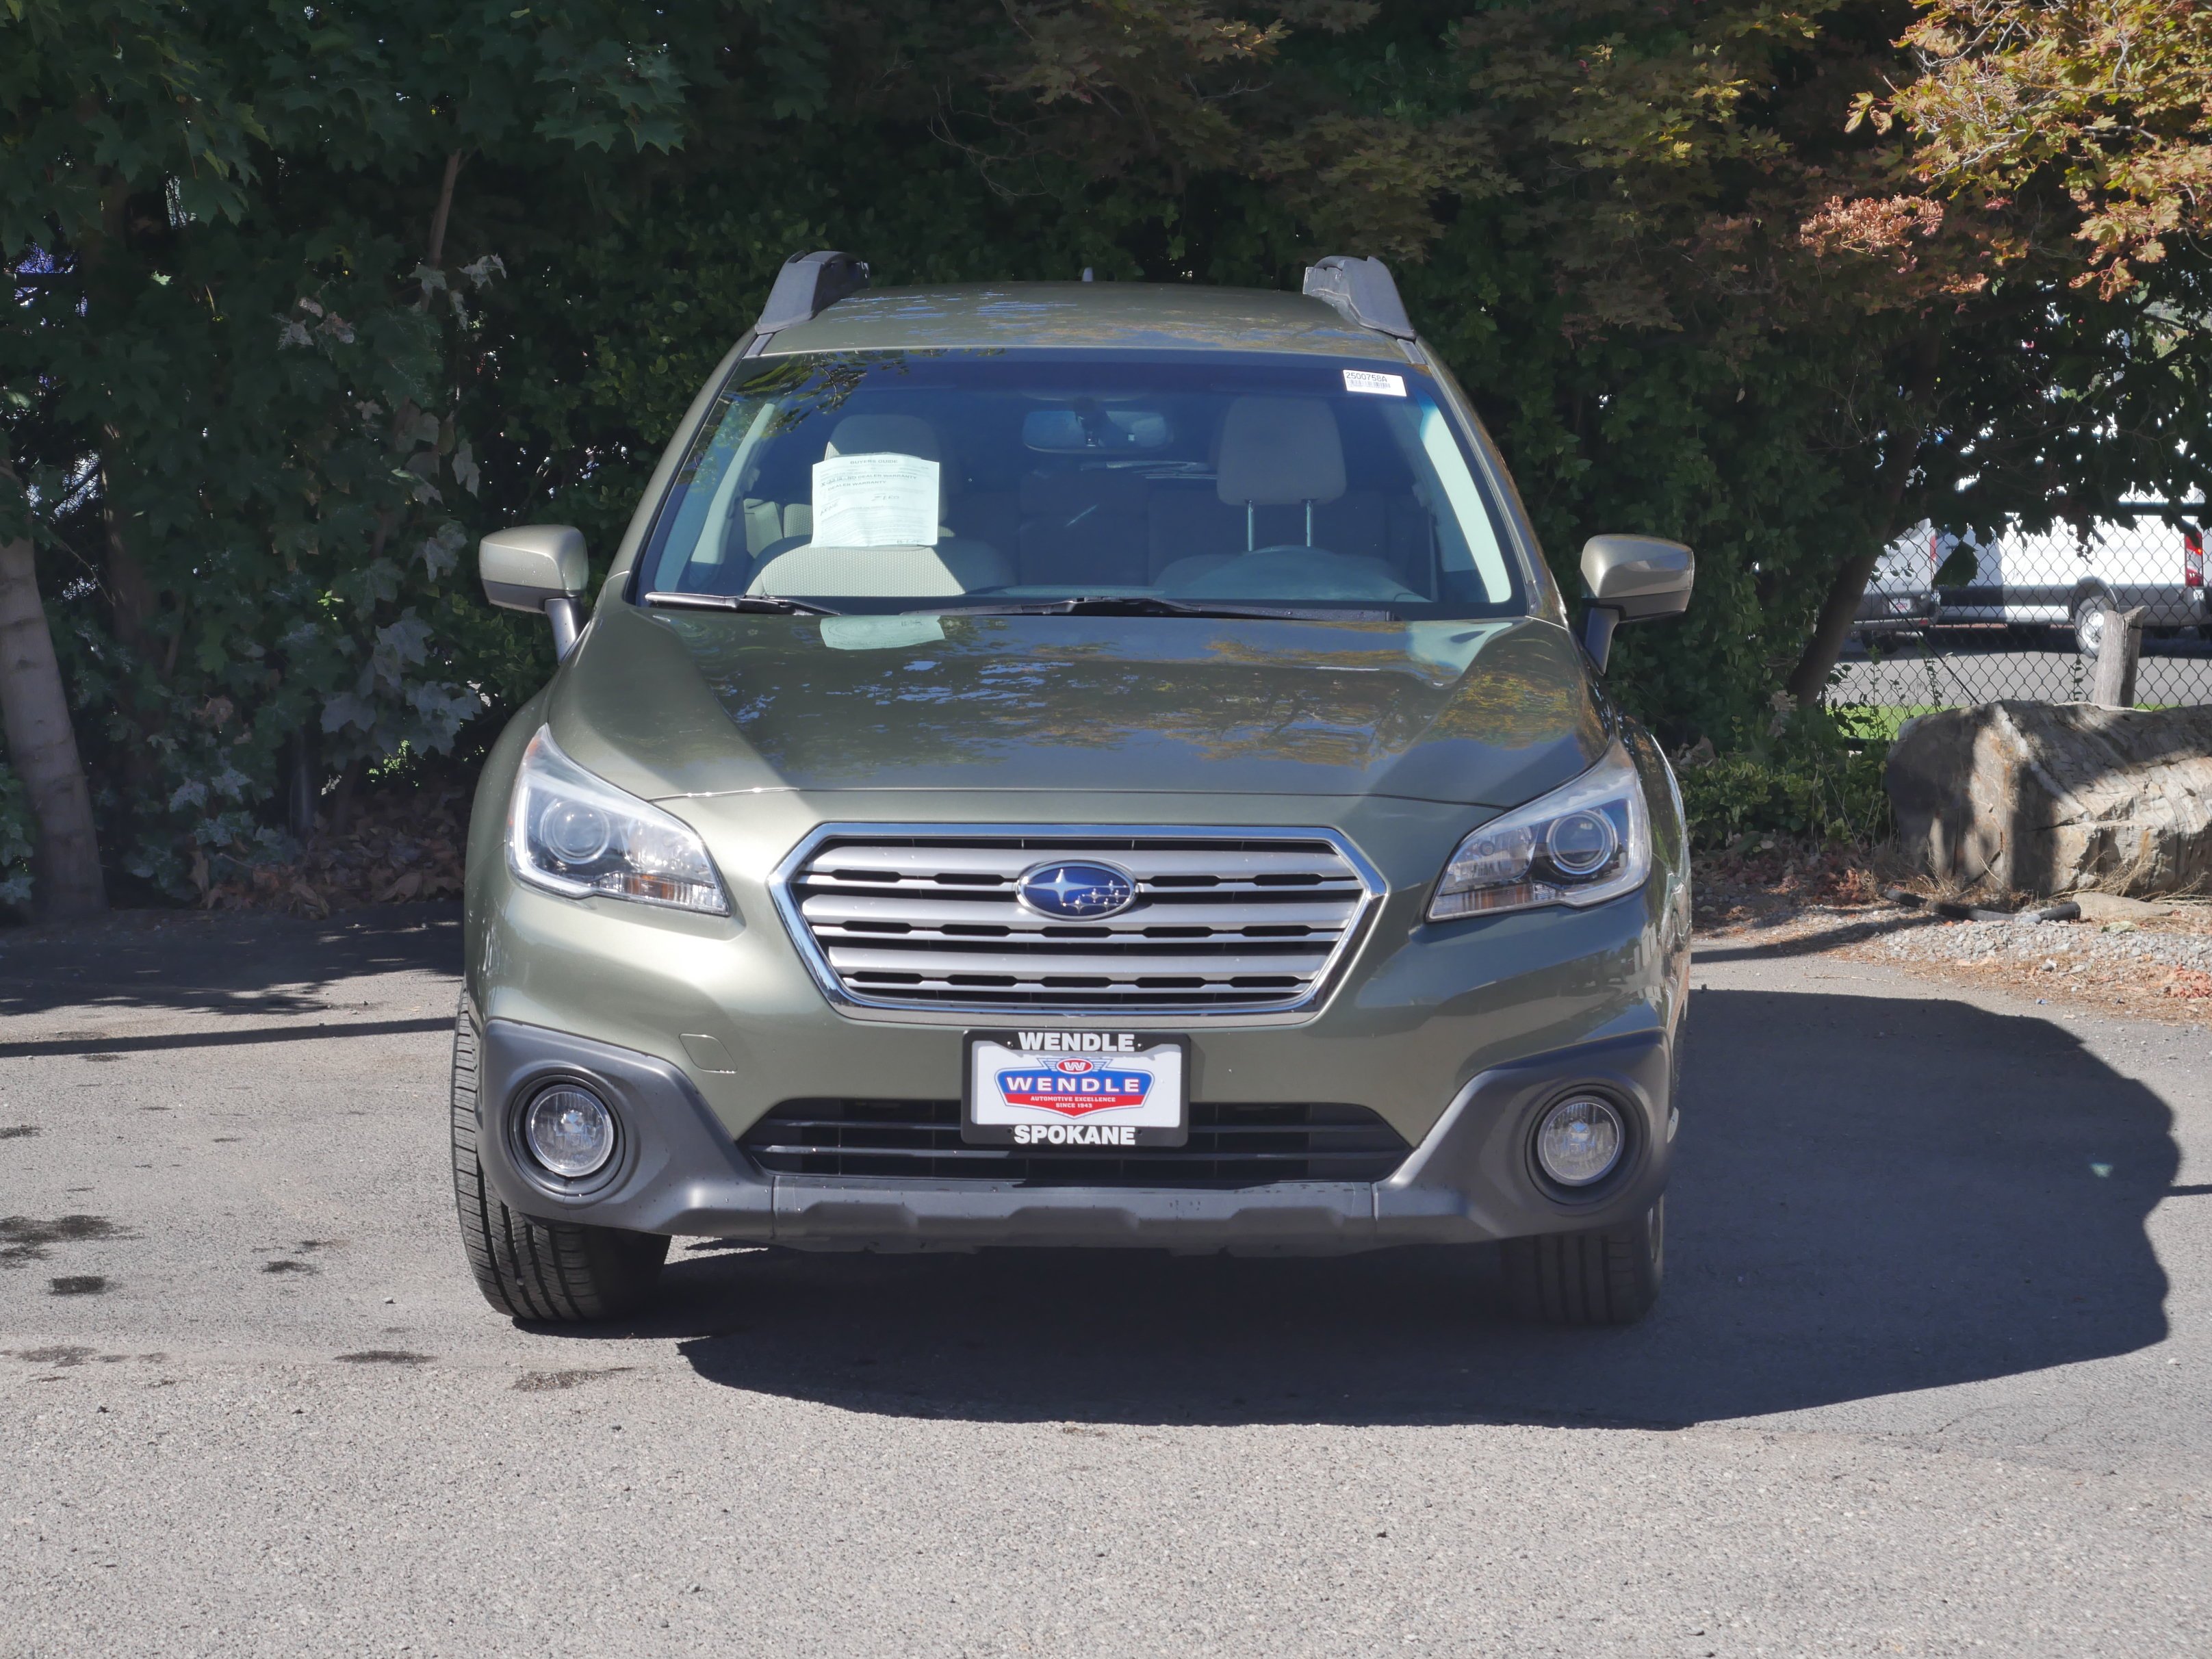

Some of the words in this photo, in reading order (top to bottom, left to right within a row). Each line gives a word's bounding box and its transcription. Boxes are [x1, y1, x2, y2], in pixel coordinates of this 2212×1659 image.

[1346, 372, 1387, 382] 2500758A
[1018, 1032, 1135, 1052] WENDLE
[1006, 1077, 1140, 1092] WENDLE
[1014, 1124, 1135, 1145] SPOKANE
